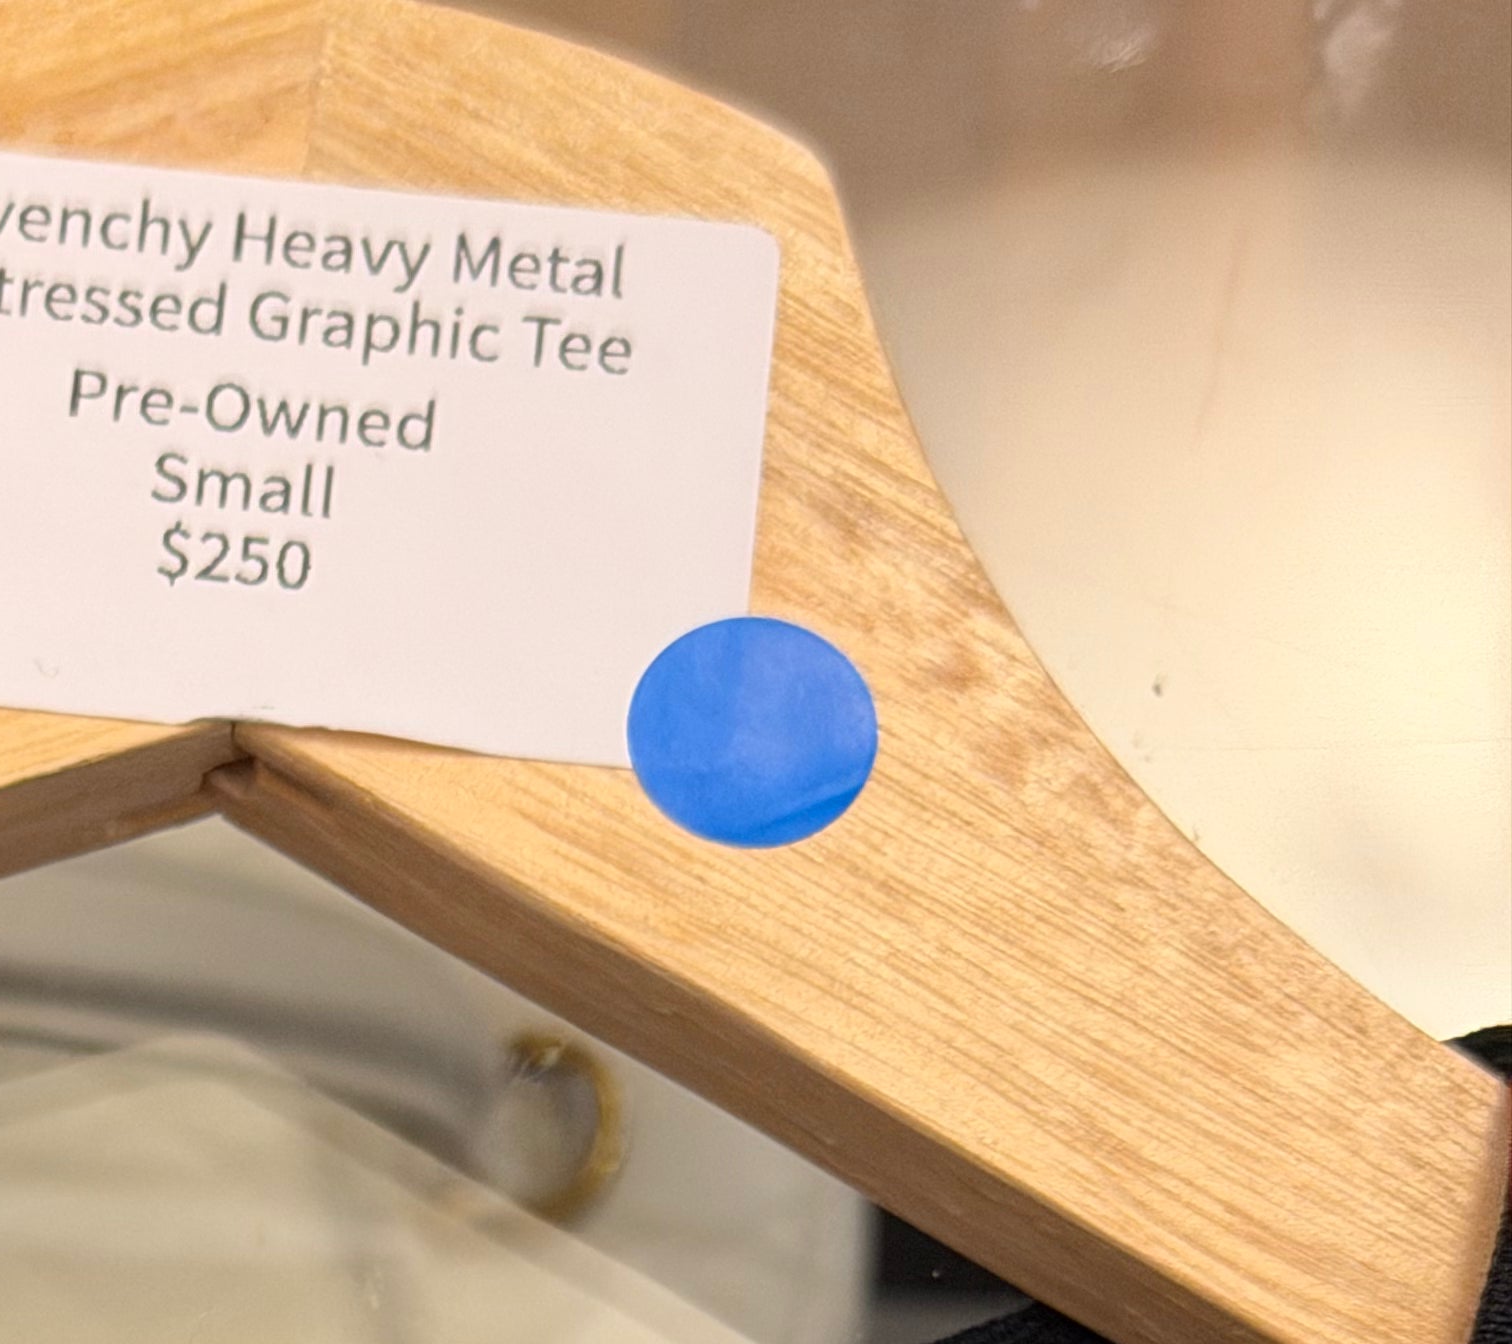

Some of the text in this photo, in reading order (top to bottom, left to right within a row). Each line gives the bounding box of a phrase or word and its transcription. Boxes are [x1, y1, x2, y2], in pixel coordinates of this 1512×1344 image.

[232, 210, 431, 293] Heavy
[452, 231, 625, 299] Metal
[248, 290, 500, 366] Graphic
[522, 315, 633, 375] Tee
[68, 367, 437, 452] Pre-Owned
[150, 451, 335, 519] Small
[156, 519, 312, 590] $250
